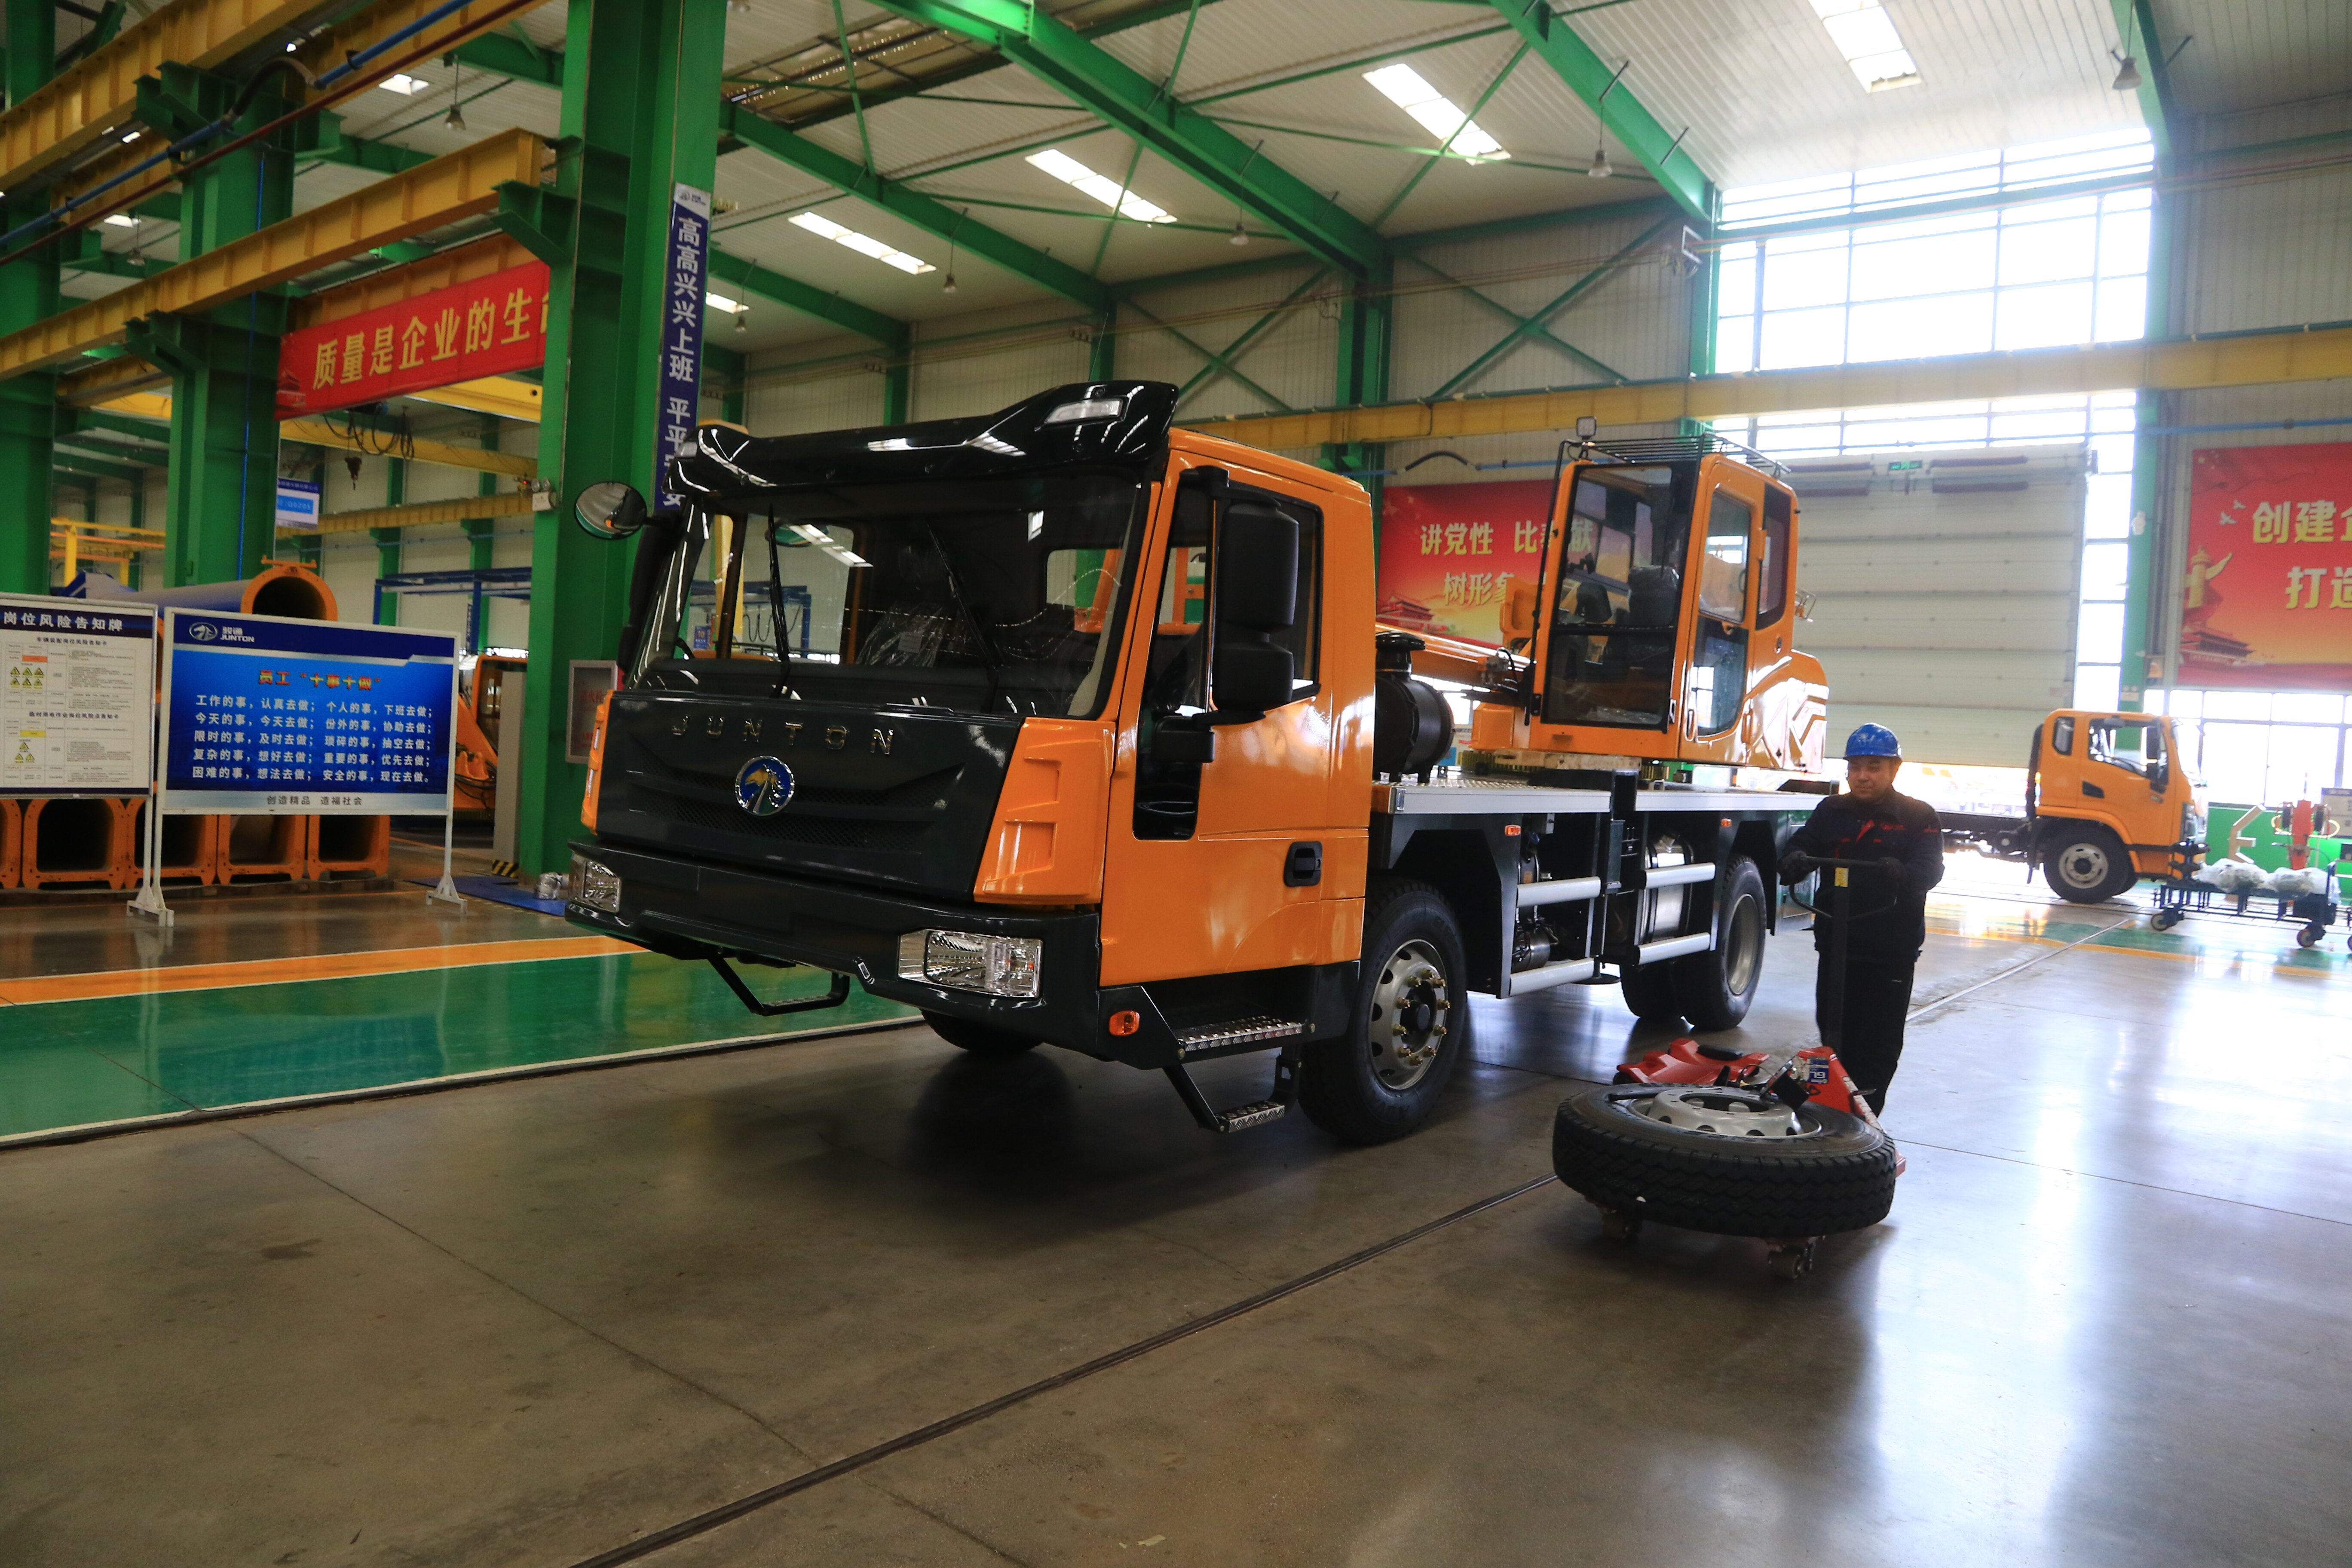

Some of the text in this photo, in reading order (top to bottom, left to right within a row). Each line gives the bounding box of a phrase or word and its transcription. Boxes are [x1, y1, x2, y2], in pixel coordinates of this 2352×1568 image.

[669, 216, 702, 382] 高高兴兴上班
[312, 288, 550, 390] 质量是企业的生
[1419, 521, 1494, 556] 讲党性
[2253, 499, 2352, 544] 创建
[3, 611, 123, 631] 岗位风险告知牌
[220, 634, 254, 643] JUNTON
[259, 670, 290, 685] 员工
[672, 715, 894, 755] JUNTON
[267, 796, 362, 805] 创造精品 造福社会
